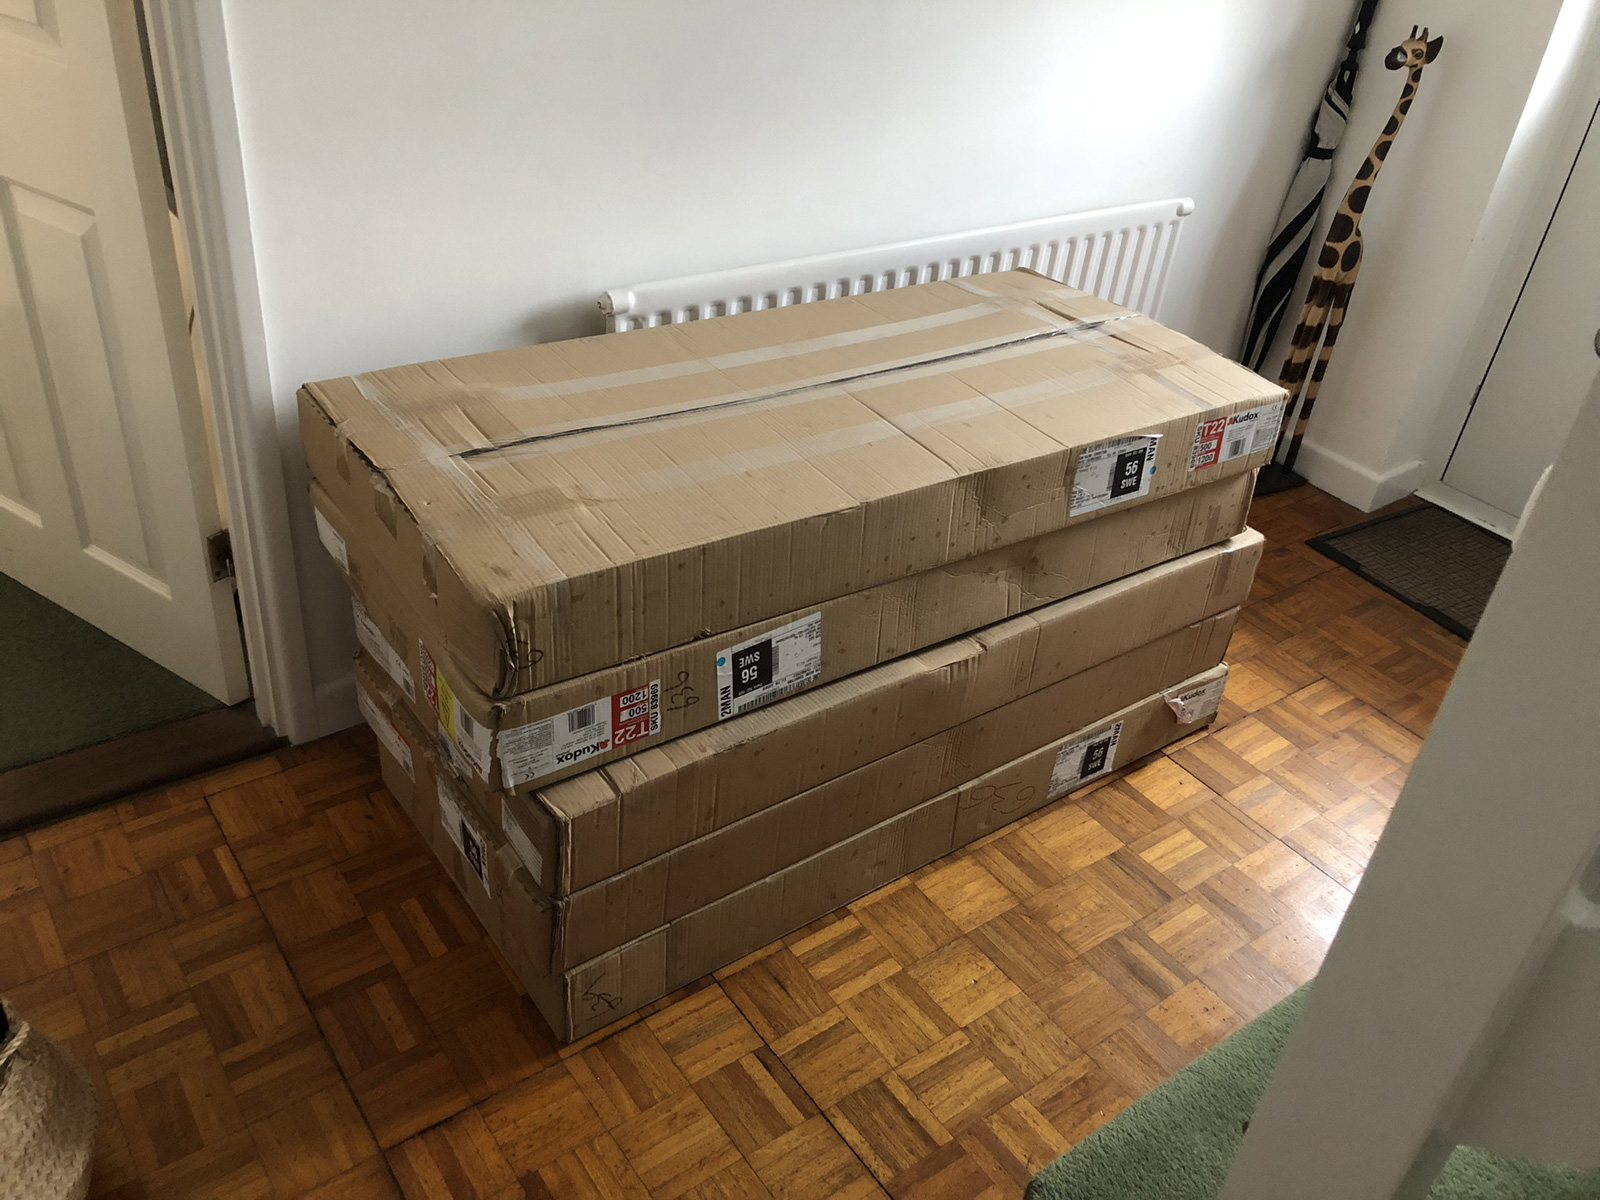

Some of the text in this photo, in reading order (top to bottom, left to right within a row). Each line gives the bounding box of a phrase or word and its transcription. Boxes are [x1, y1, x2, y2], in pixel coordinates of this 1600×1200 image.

[1232, 411, 1260, 425] Kudox
[1194, 425, 1203, 444] SKU
[1203, 418, 1226, 437] T22
[1146, 437, 1158, 461] MAN
[1199, 442, 1212, 451] 500
[1197, 453, 1214, 464] 1200
[1125, 460, 1139, 476] 56
[1120, 476, 1138, 489] SWE
[738, 651, 761, 669] SWE
[741, 665, 758, 684] 56
[622, 690, 647, 706] 1200
[720, 685, 732, 718] 2MAN
[628, 703, 648, 718] 500
[650, 683, 659, 732] SKU 83969
[613, 721, 649, 745] T22
[555, 742, 600, 765] Kudox
